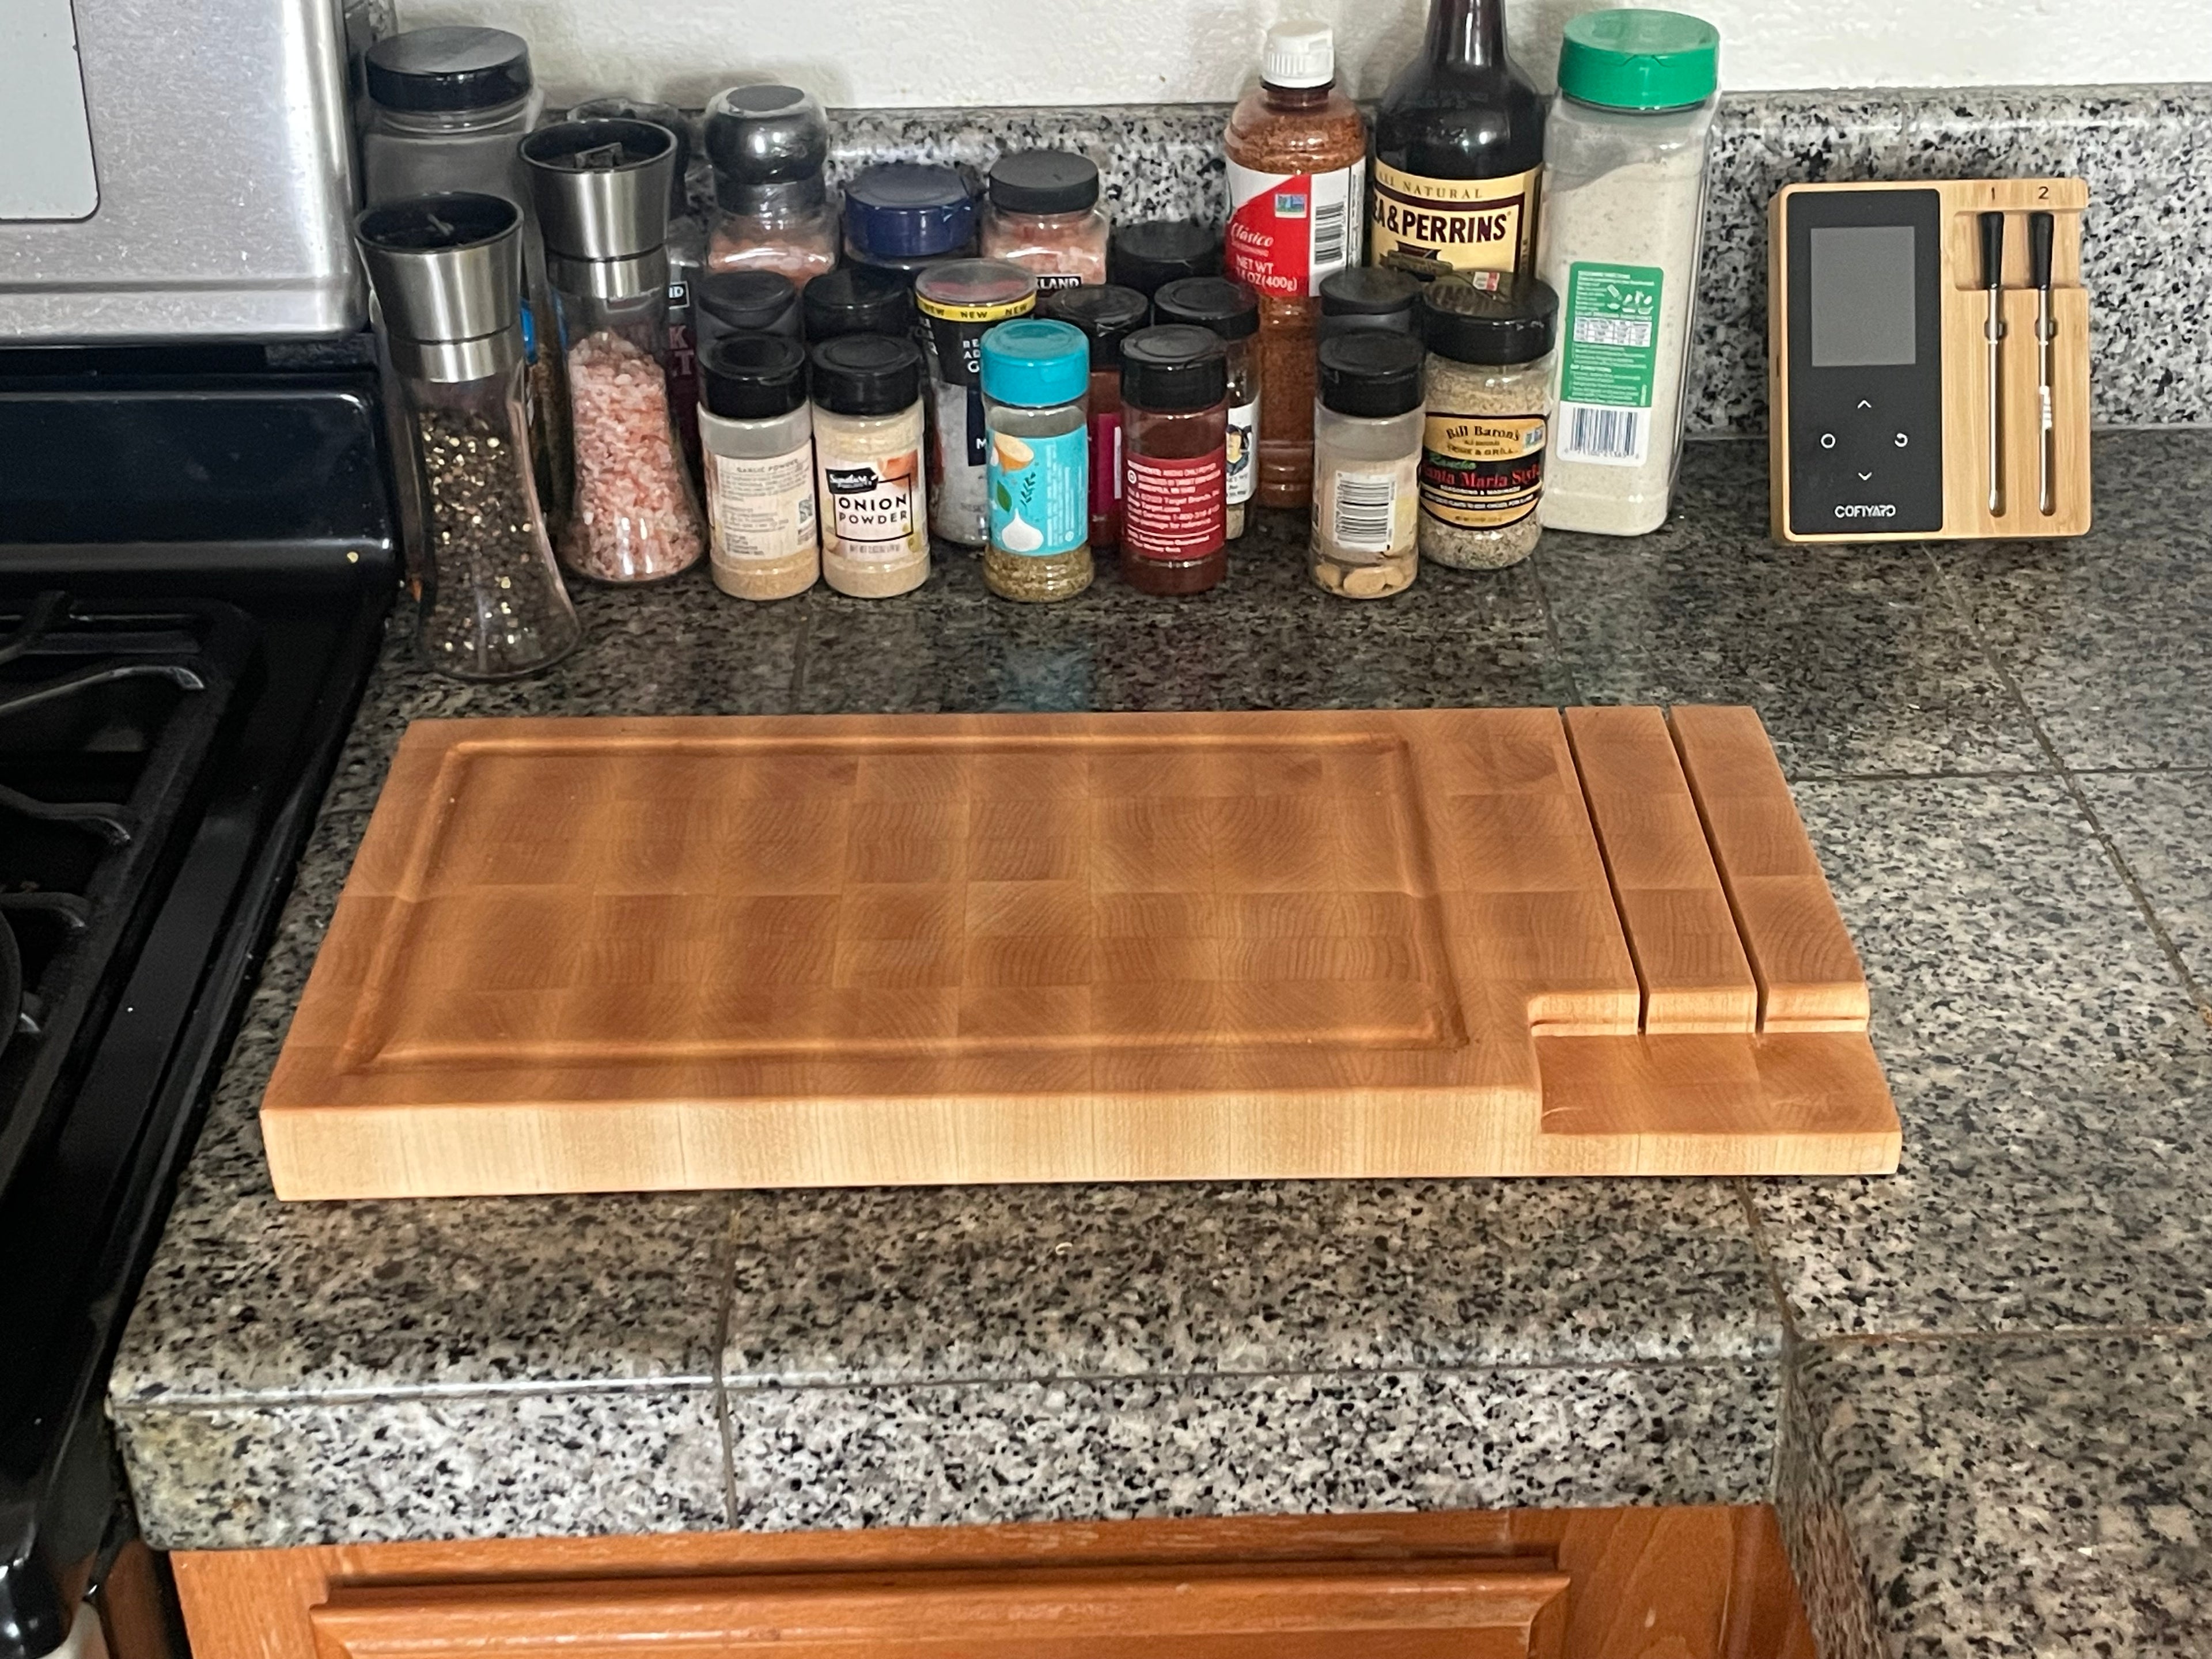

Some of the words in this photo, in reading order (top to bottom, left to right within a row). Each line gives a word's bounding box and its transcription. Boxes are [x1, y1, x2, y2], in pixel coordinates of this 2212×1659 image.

[1403, 180, 1483, 199] NATURAL
[1991, 185, 1995, 200] 1
[2037, 186, 2049, 200] 2
[1387, 204, 1399, 234] &
[1402, 209, 1507, 243] PERRINS
[1236, 254, 1253, 270] NET
[1255, 260, 1274, 275] WT
[1039, 277, 1080, 289] LAND
[1005, 304, 1028, 316] NEW
[1446, 425, 1469, 440] Bill
[1460, 471, 1508, 488] Maria
[838, 493, 907, 511] ONION
[839, 510, 908, 525] POWDER
